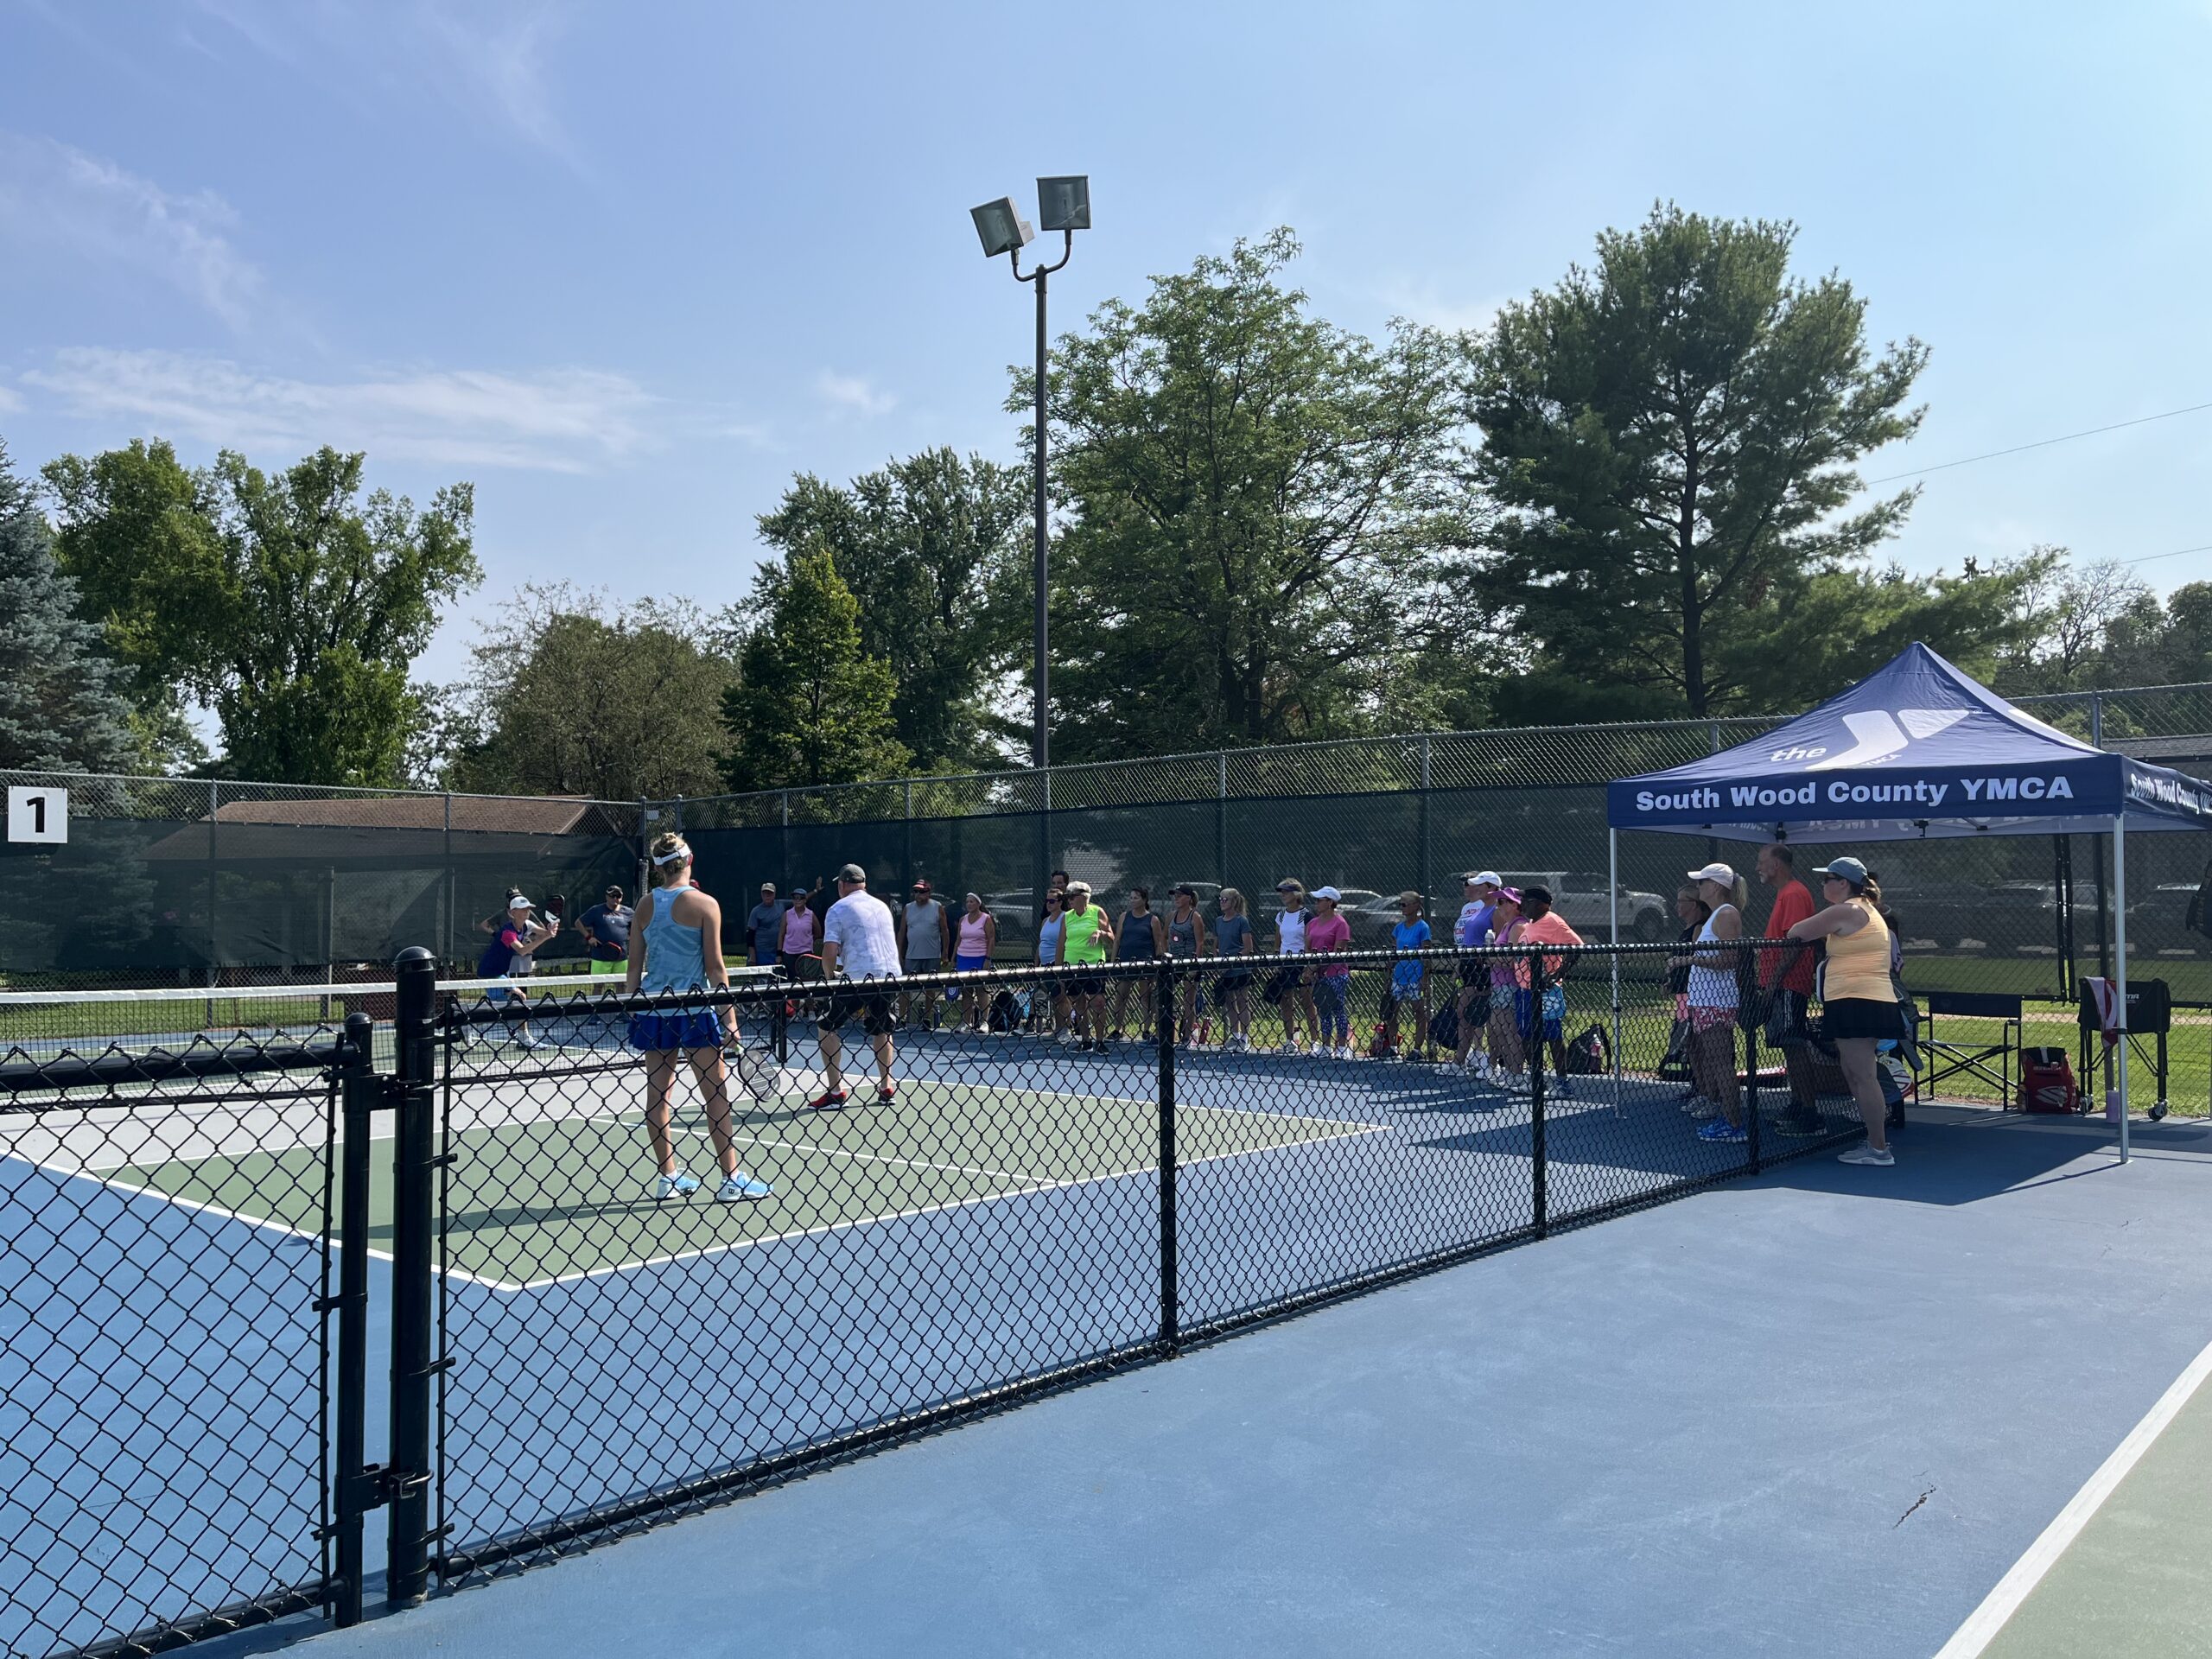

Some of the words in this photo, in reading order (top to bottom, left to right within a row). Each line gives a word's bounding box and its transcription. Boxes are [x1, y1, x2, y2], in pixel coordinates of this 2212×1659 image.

[1770, 747, 1827, 761] the
[1860, 754, 1902, 766] YMCA
[1636, 787, 1719, 810] South
[1731, 782, 1815, 807] Wood
[1827, 781, 1948, 806] County
[1960, 776, 2074, 800] YMCA
[2131, 773, 2155, 799] South
[2154, 779, 2177, 803] Wood
[2177, 783, 2199, 815] County
[26, 797, 45, 833] 1
